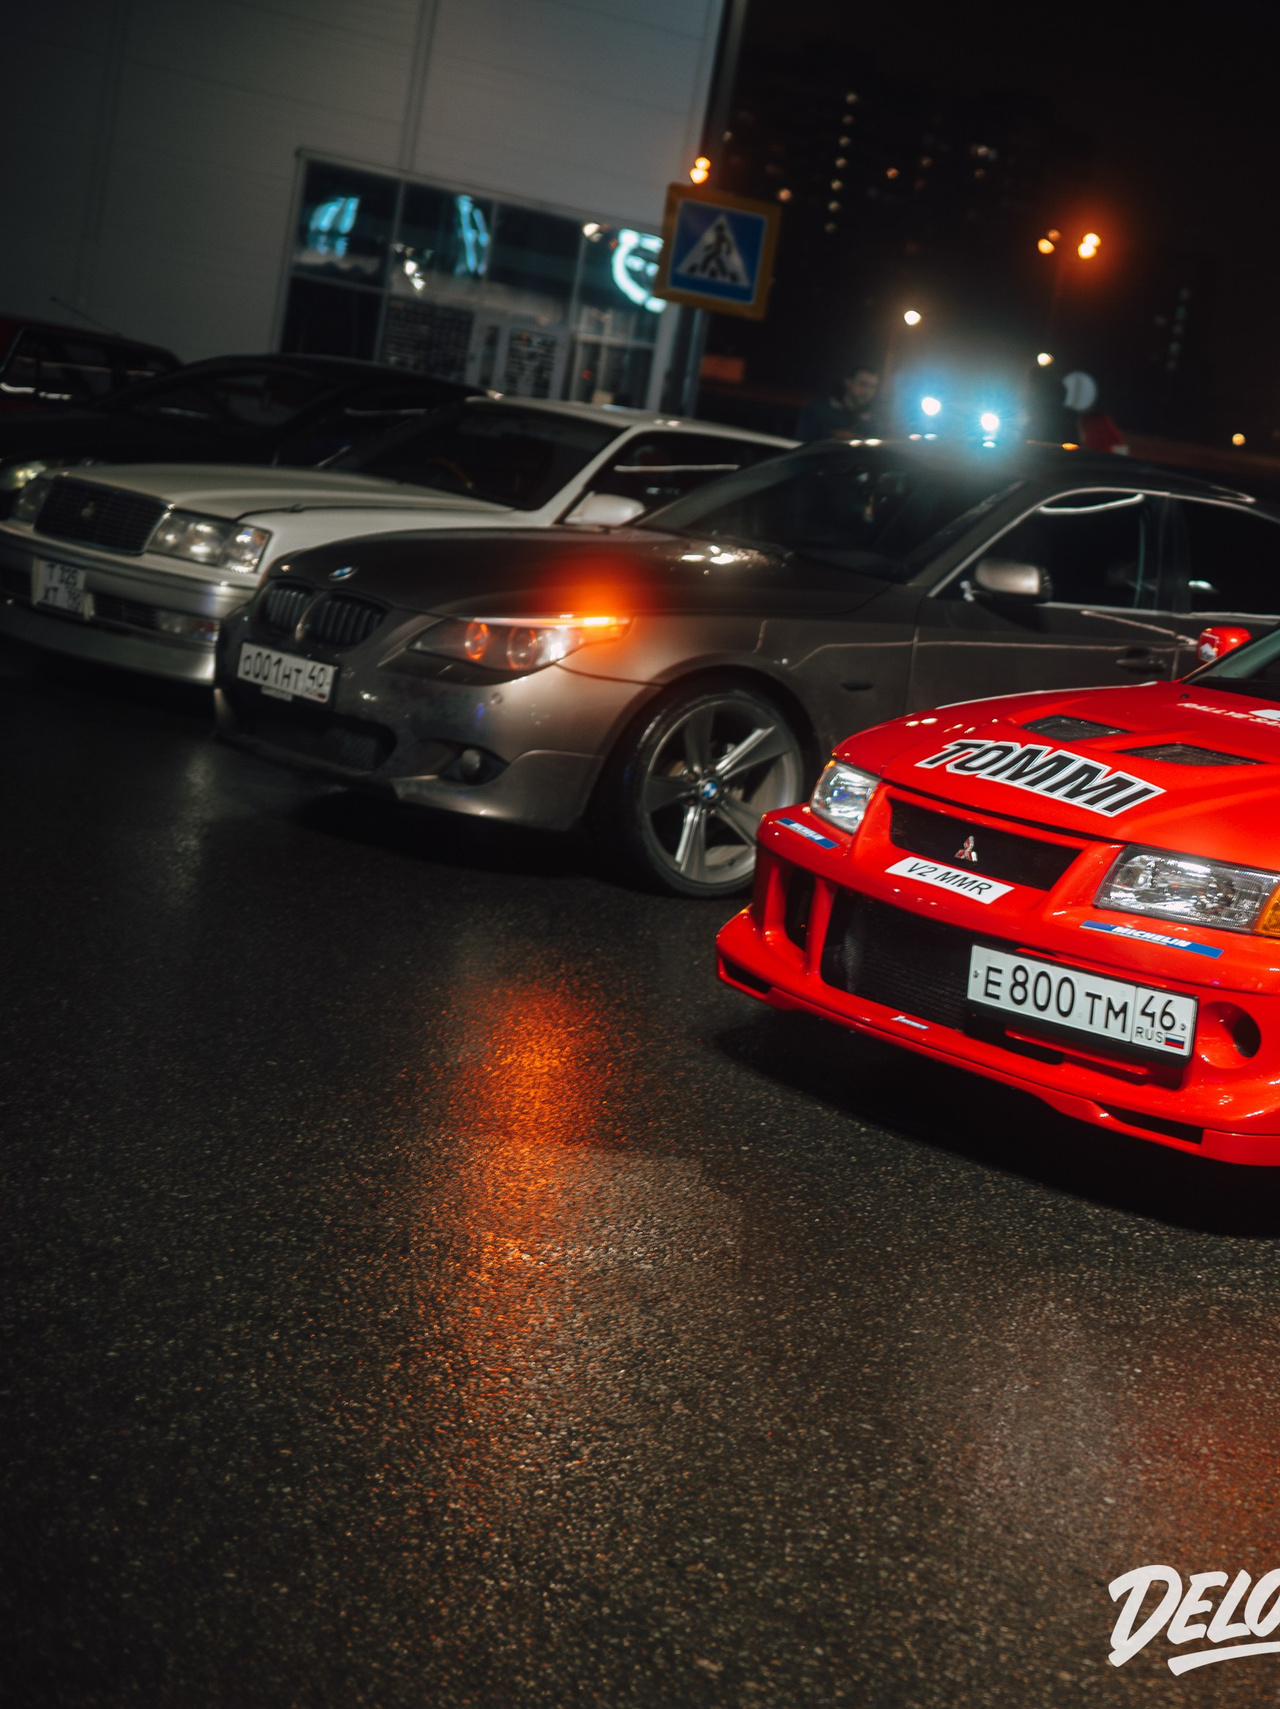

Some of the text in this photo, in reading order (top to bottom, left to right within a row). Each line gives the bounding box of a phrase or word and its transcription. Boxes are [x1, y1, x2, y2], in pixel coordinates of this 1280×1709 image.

[914, 739, 1168, 817] TOMMI
[907, 861, 993, 896] V2 MMR
[1111, 926, 1193, 948] MICHELIN
[1140, 995, 1176, 1031] 46
[1135, 1026, 1164, 1044] RUS
